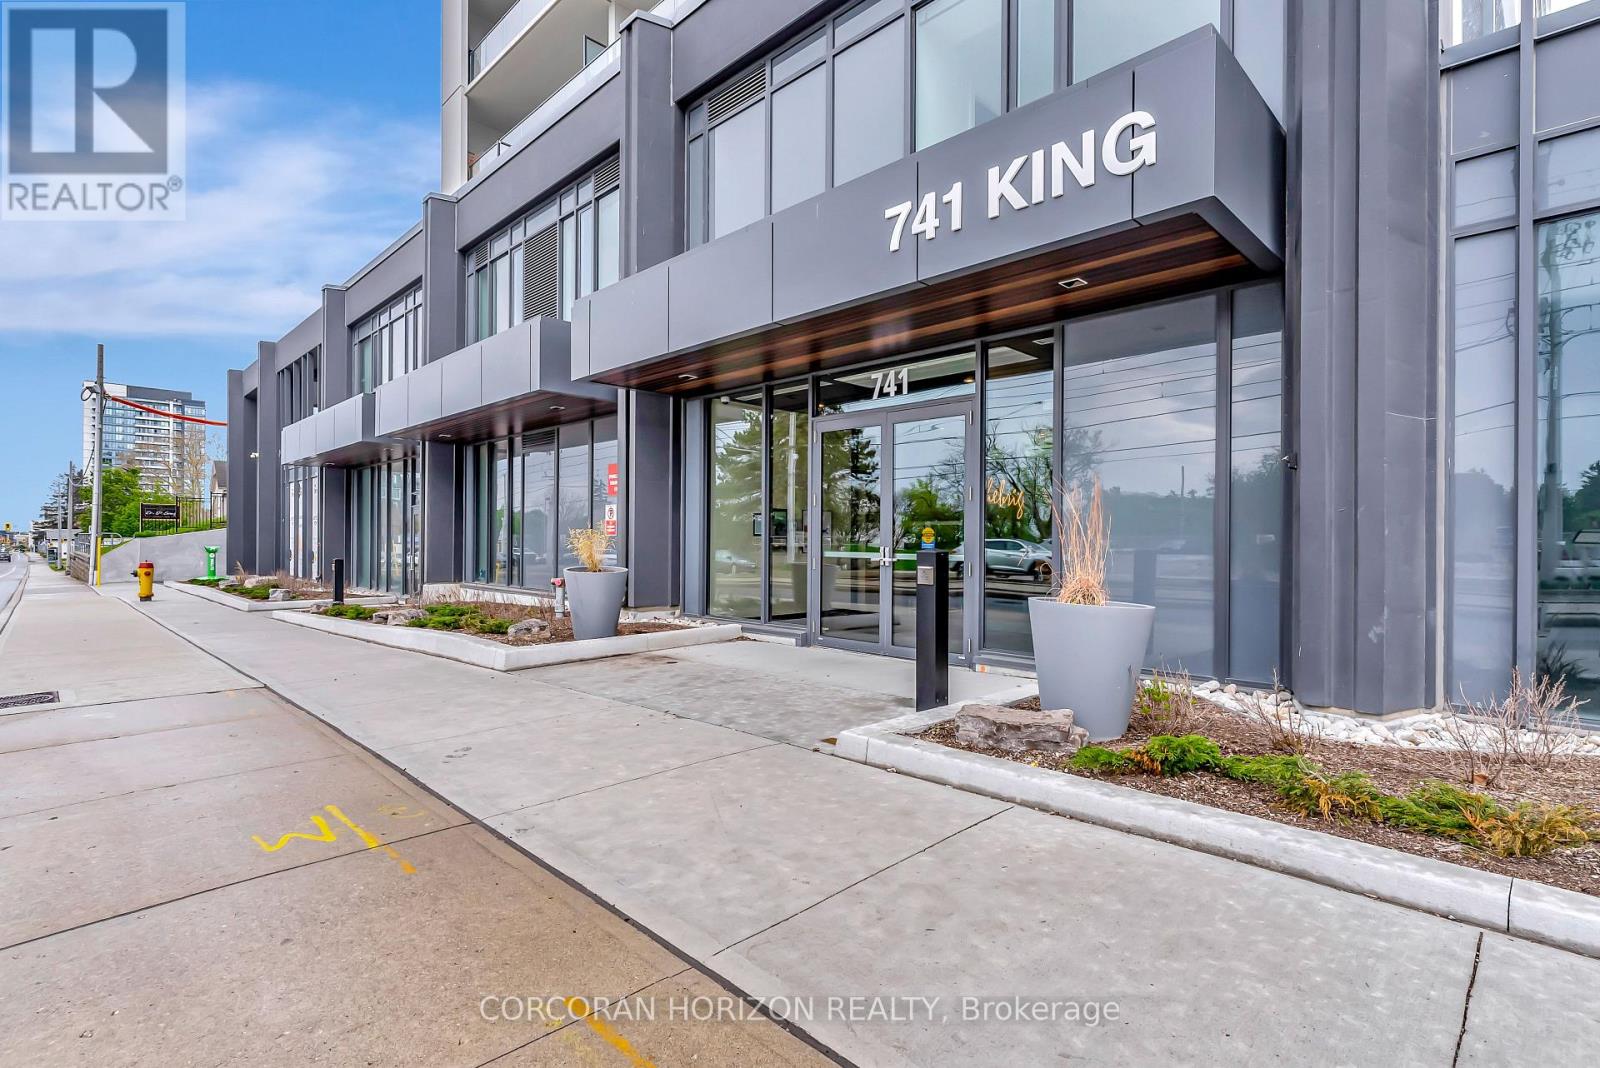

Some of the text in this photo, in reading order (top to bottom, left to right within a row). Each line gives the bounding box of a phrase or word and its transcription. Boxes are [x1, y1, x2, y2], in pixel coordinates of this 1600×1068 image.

[884, 110, 1157, 253] 741 KING
[871, 368, 908, 400] 741
